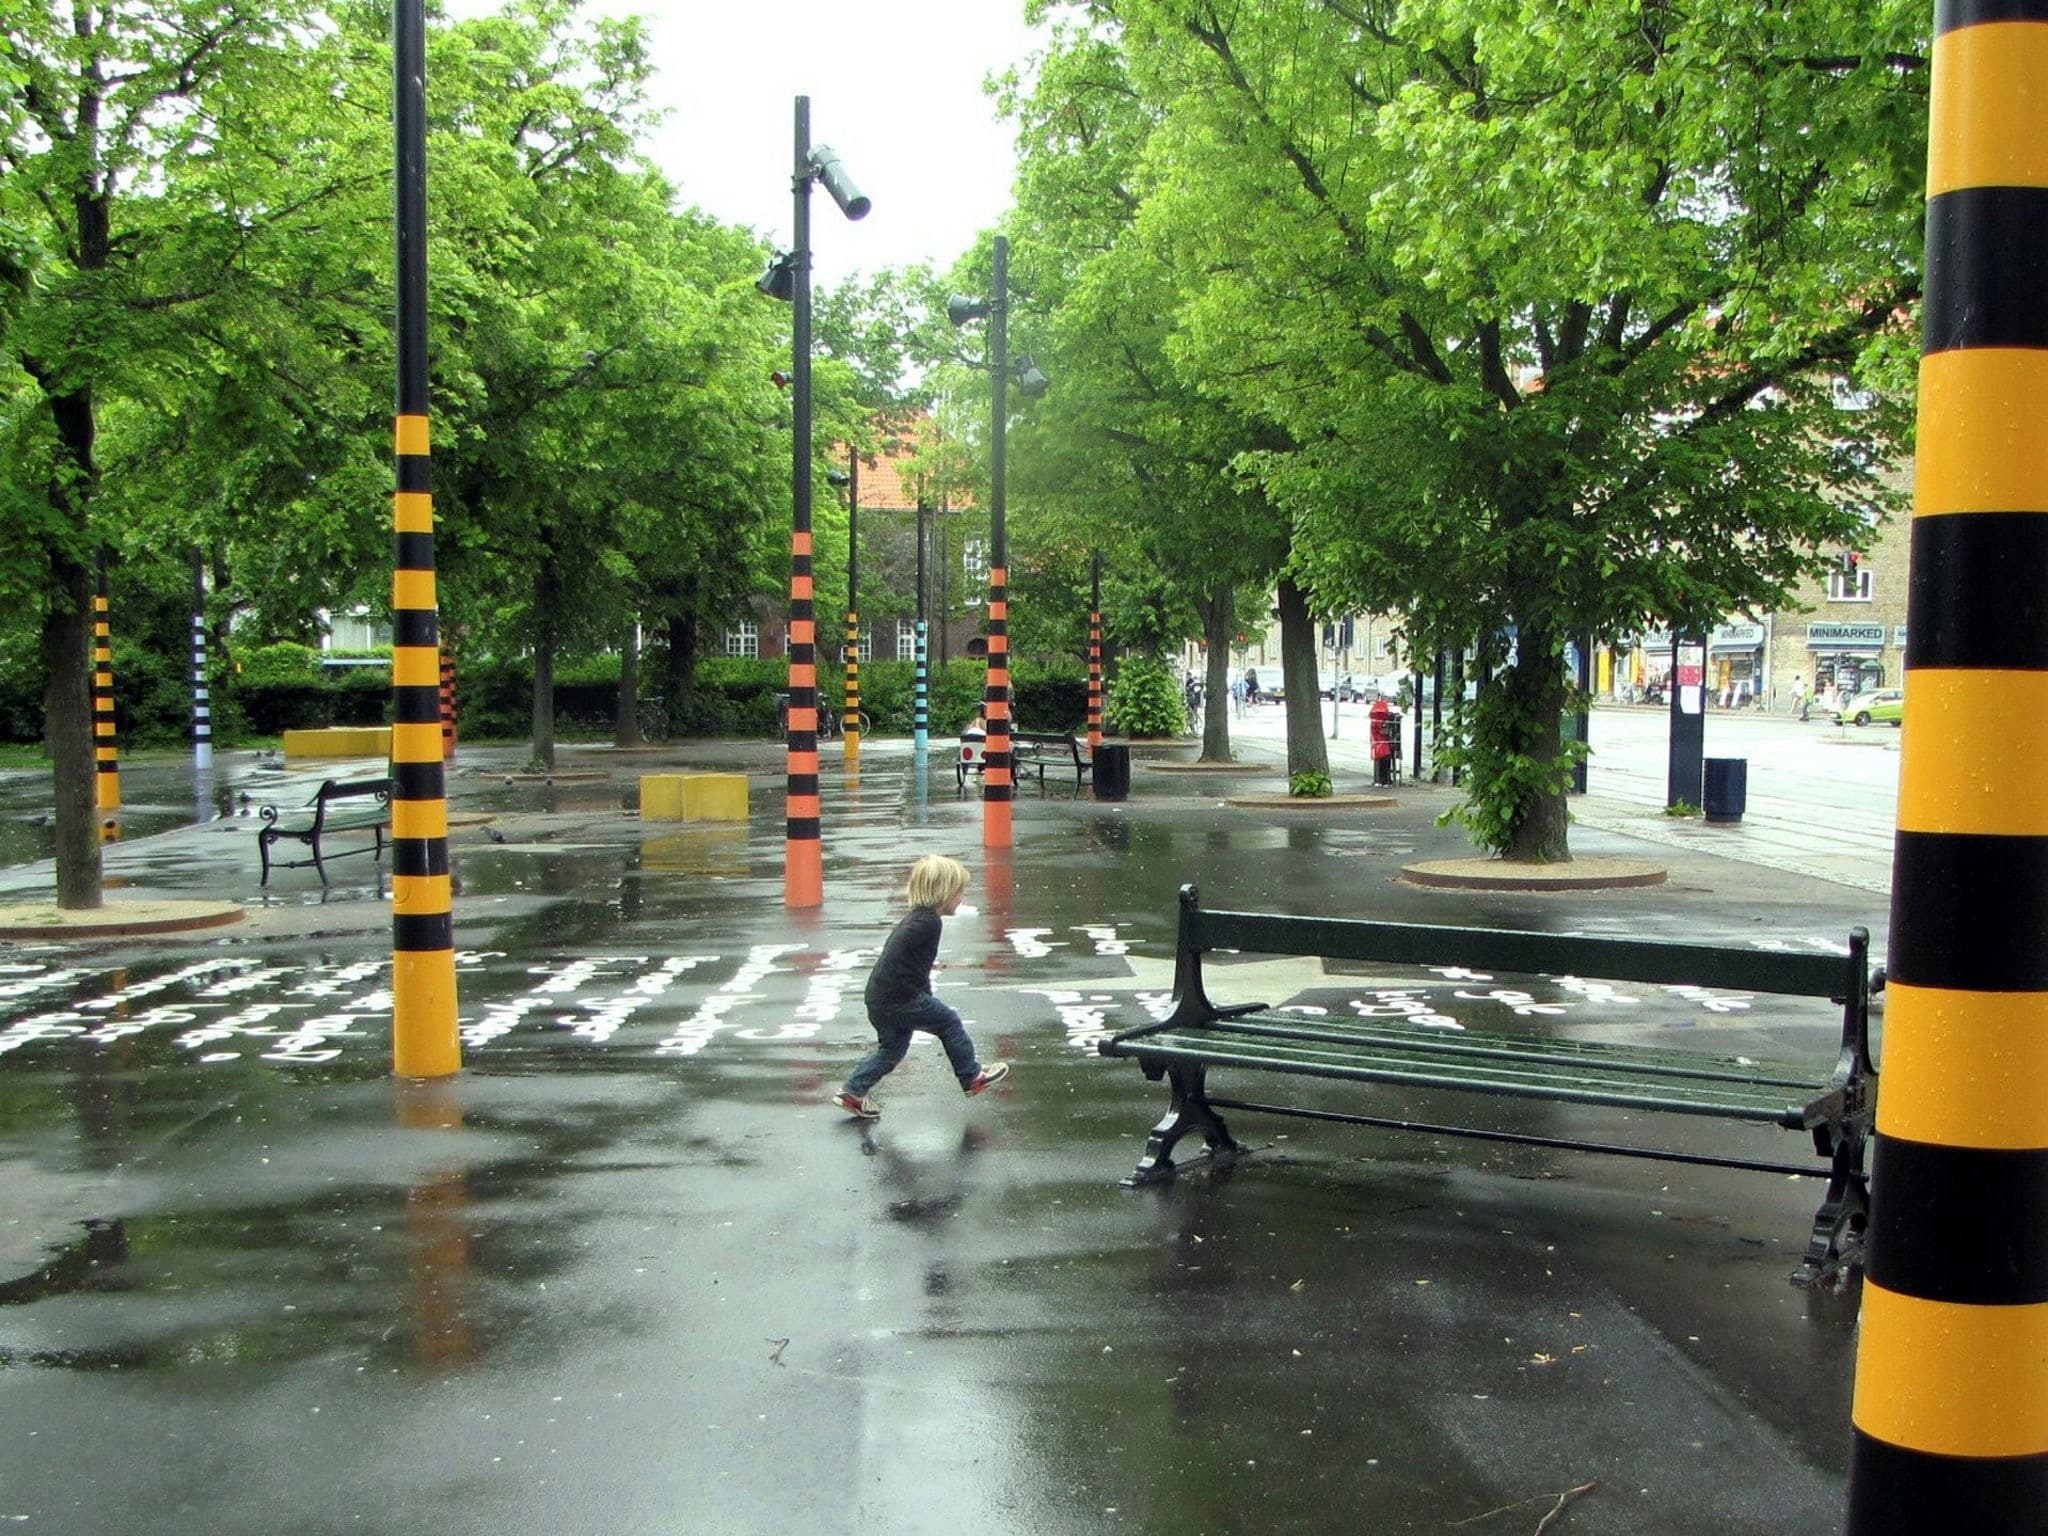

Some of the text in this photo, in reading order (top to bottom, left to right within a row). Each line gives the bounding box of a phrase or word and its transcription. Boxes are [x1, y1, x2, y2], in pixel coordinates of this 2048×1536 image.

[1809, 628, 1882, 639] MINIMARKED
[526, 956, 649, 993] Fuglene
[1349, 989, 1465, 1030] kigger
[1454, 990, 1576, 1015] gule
